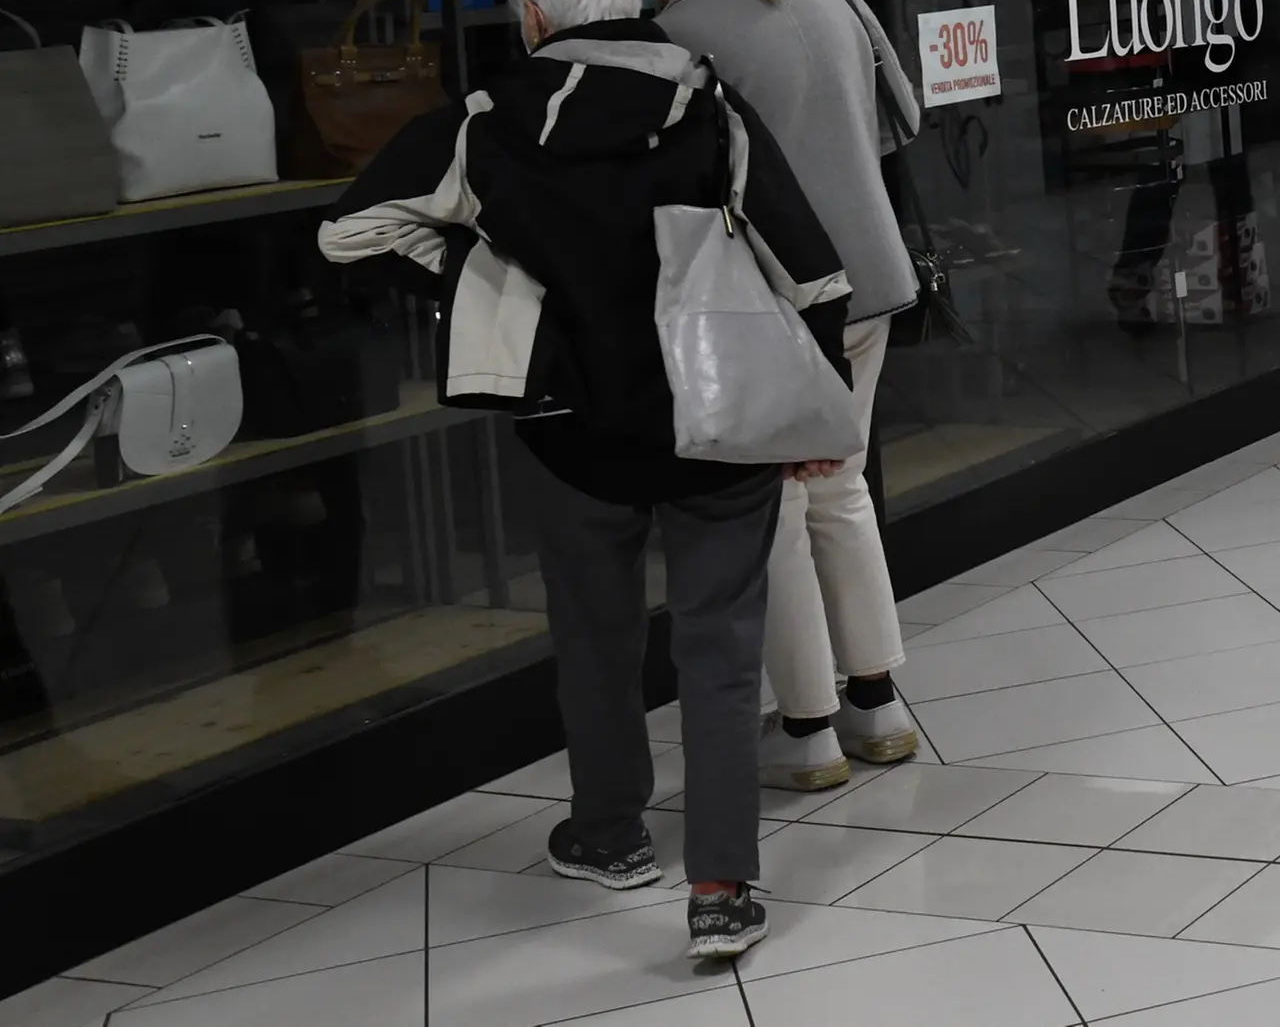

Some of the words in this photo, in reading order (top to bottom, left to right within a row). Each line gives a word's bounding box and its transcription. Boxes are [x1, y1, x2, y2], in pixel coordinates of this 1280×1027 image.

[929, 20, 989, 70] -30%
[1066, 97, 1163, 133] CALZATURE
[1166, 91, 1188, 117] ED
[1190, 79, 1269, 113] ACCESSORI
